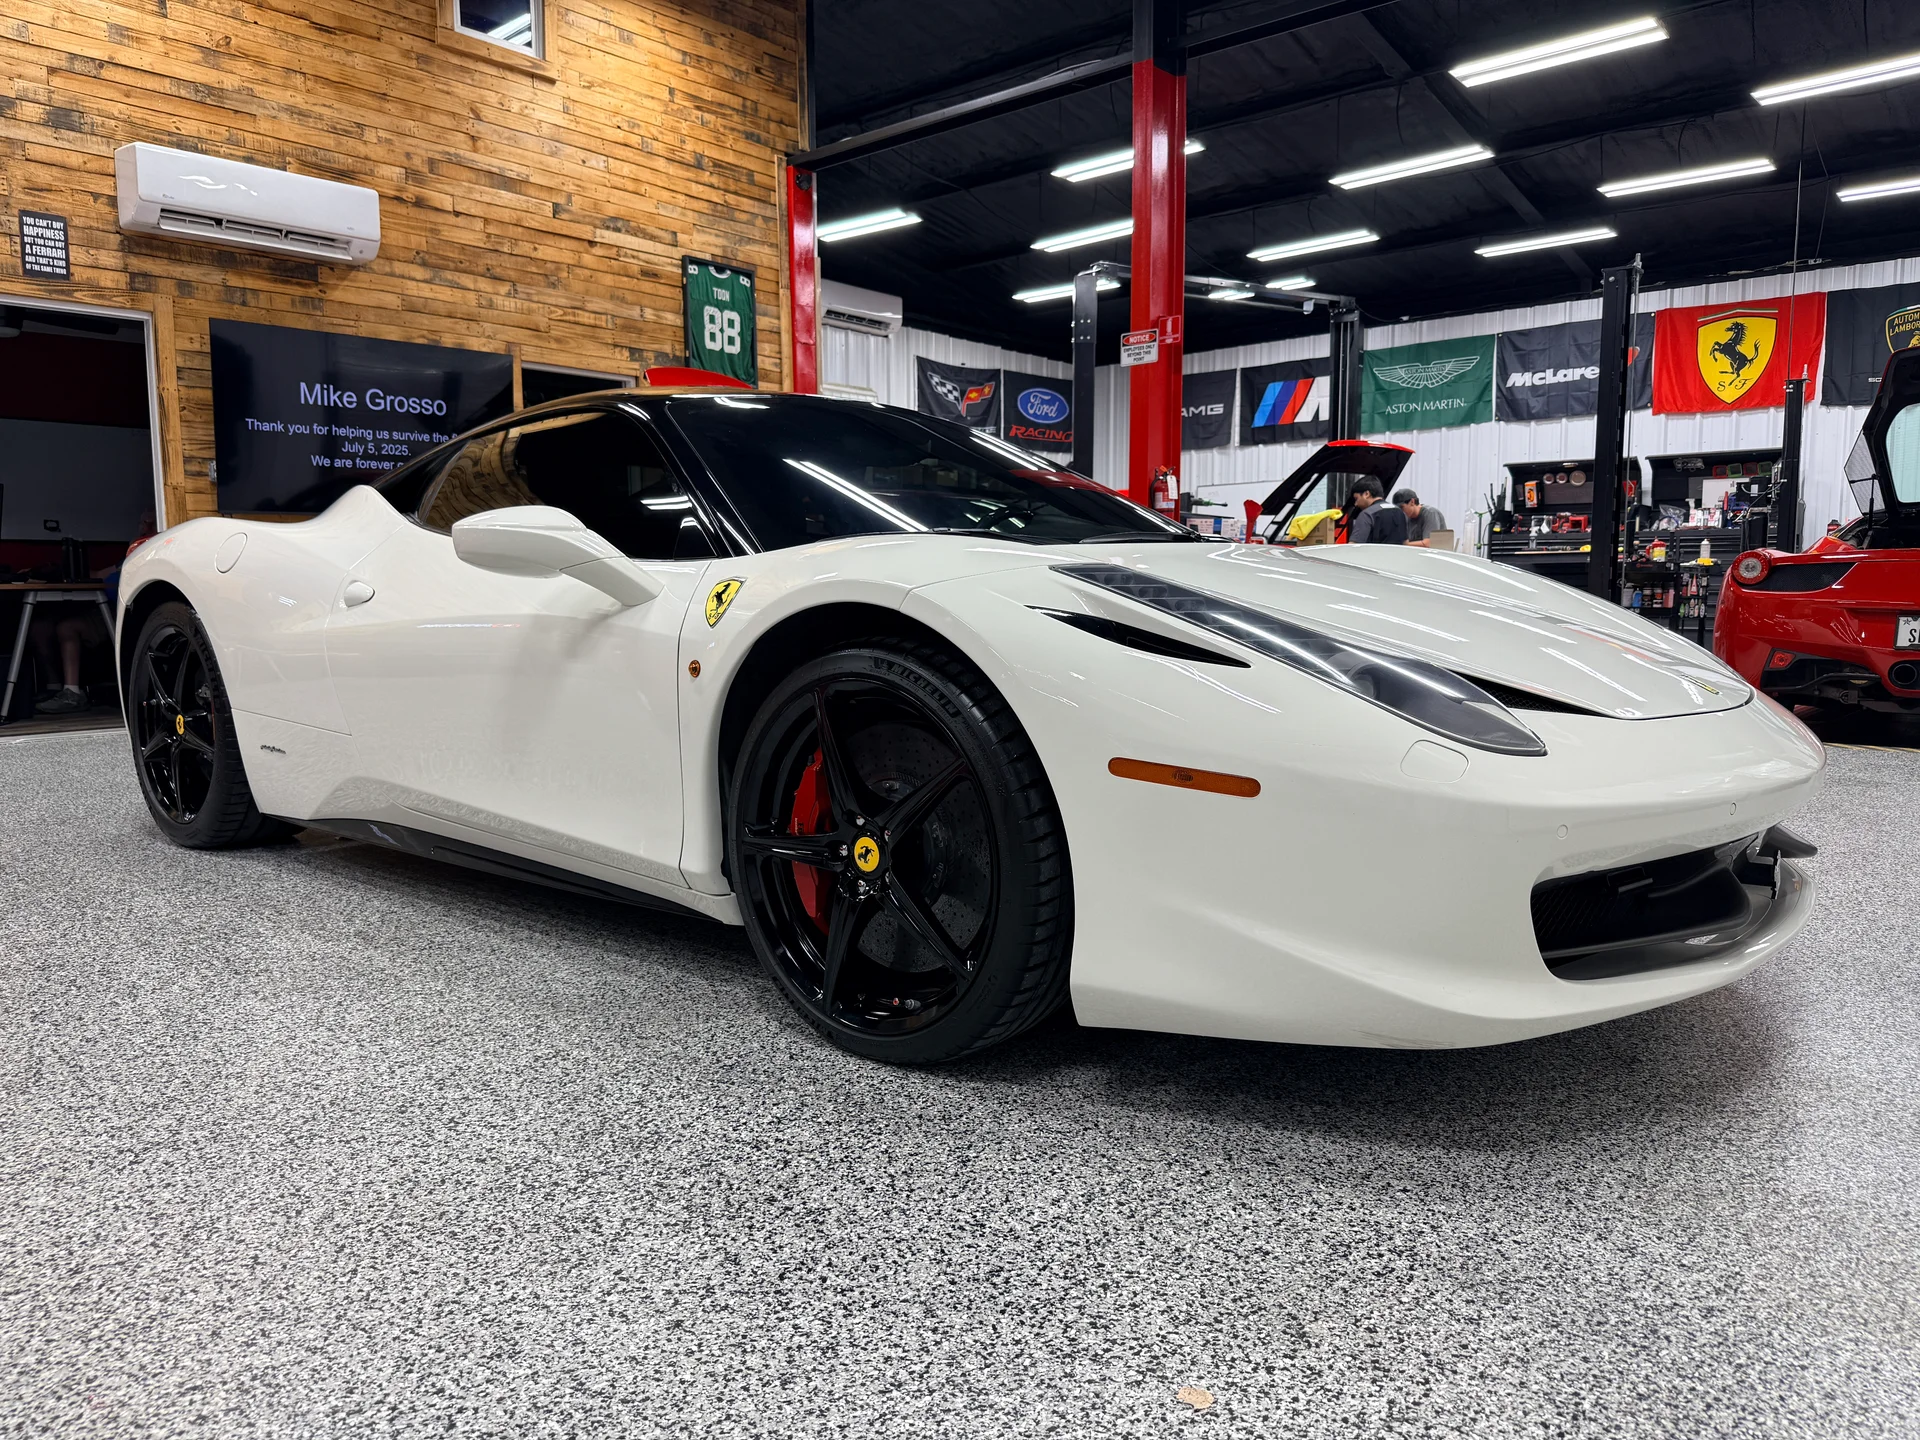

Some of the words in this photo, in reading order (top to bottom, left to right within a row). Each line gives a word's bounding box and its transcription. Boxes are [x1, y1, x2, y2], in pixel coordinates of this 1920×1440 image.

[23, 216, 34, 225] YOU
[35, 218, 51, 227] CAN'T
[52, 221, 64, 230] BUY
[23, 225, 65, 240] HAPPINESS
[25, 244, 31, 254] A
[32, 245, 66, 259] FERRARI
[713, 287, 730, 302] TOON
[1893, 312, 1920, 326] AUTOM
[703, 305, 741, 355] 88
[1889, 320, 1920, 336] LAMBOR
[1130, 334, 1150, 344] NOTICE
[1506, 365, 1600, 388] McLare
[1716, 380, 1726, 392] S
[300, 381, 358, 408] Mike
[365, 388, 447, 416] Grosso
[1027, 392, 1058, 418] Ford
[1385, 402, 1421, 415] ASTON
[1422, 398, 1465, 410] MARTIN
[245, 418, 285, 433] Thank
[287, 422, 310, 436] you
[312, 423, 329, 436] for
[331, 426, 374, 441] helping
[375, 428, 390, 440] us
[392, 430, 431, 443] survive
[432, 432, 450, 443] the
[1009, 424, 1073, 442] RACING
[341, 442, 365, 455] July
[367, 443, 379, 455] 5,
[381, 444, 412, 456] 2025.
[310, 455, 332, 467] We
[333, 458, 353, 469] are
[355, 457, 395, 470] forever
[1908, 628, 1920, 644] S
[890, 663, 958, 714] MICHELIN
